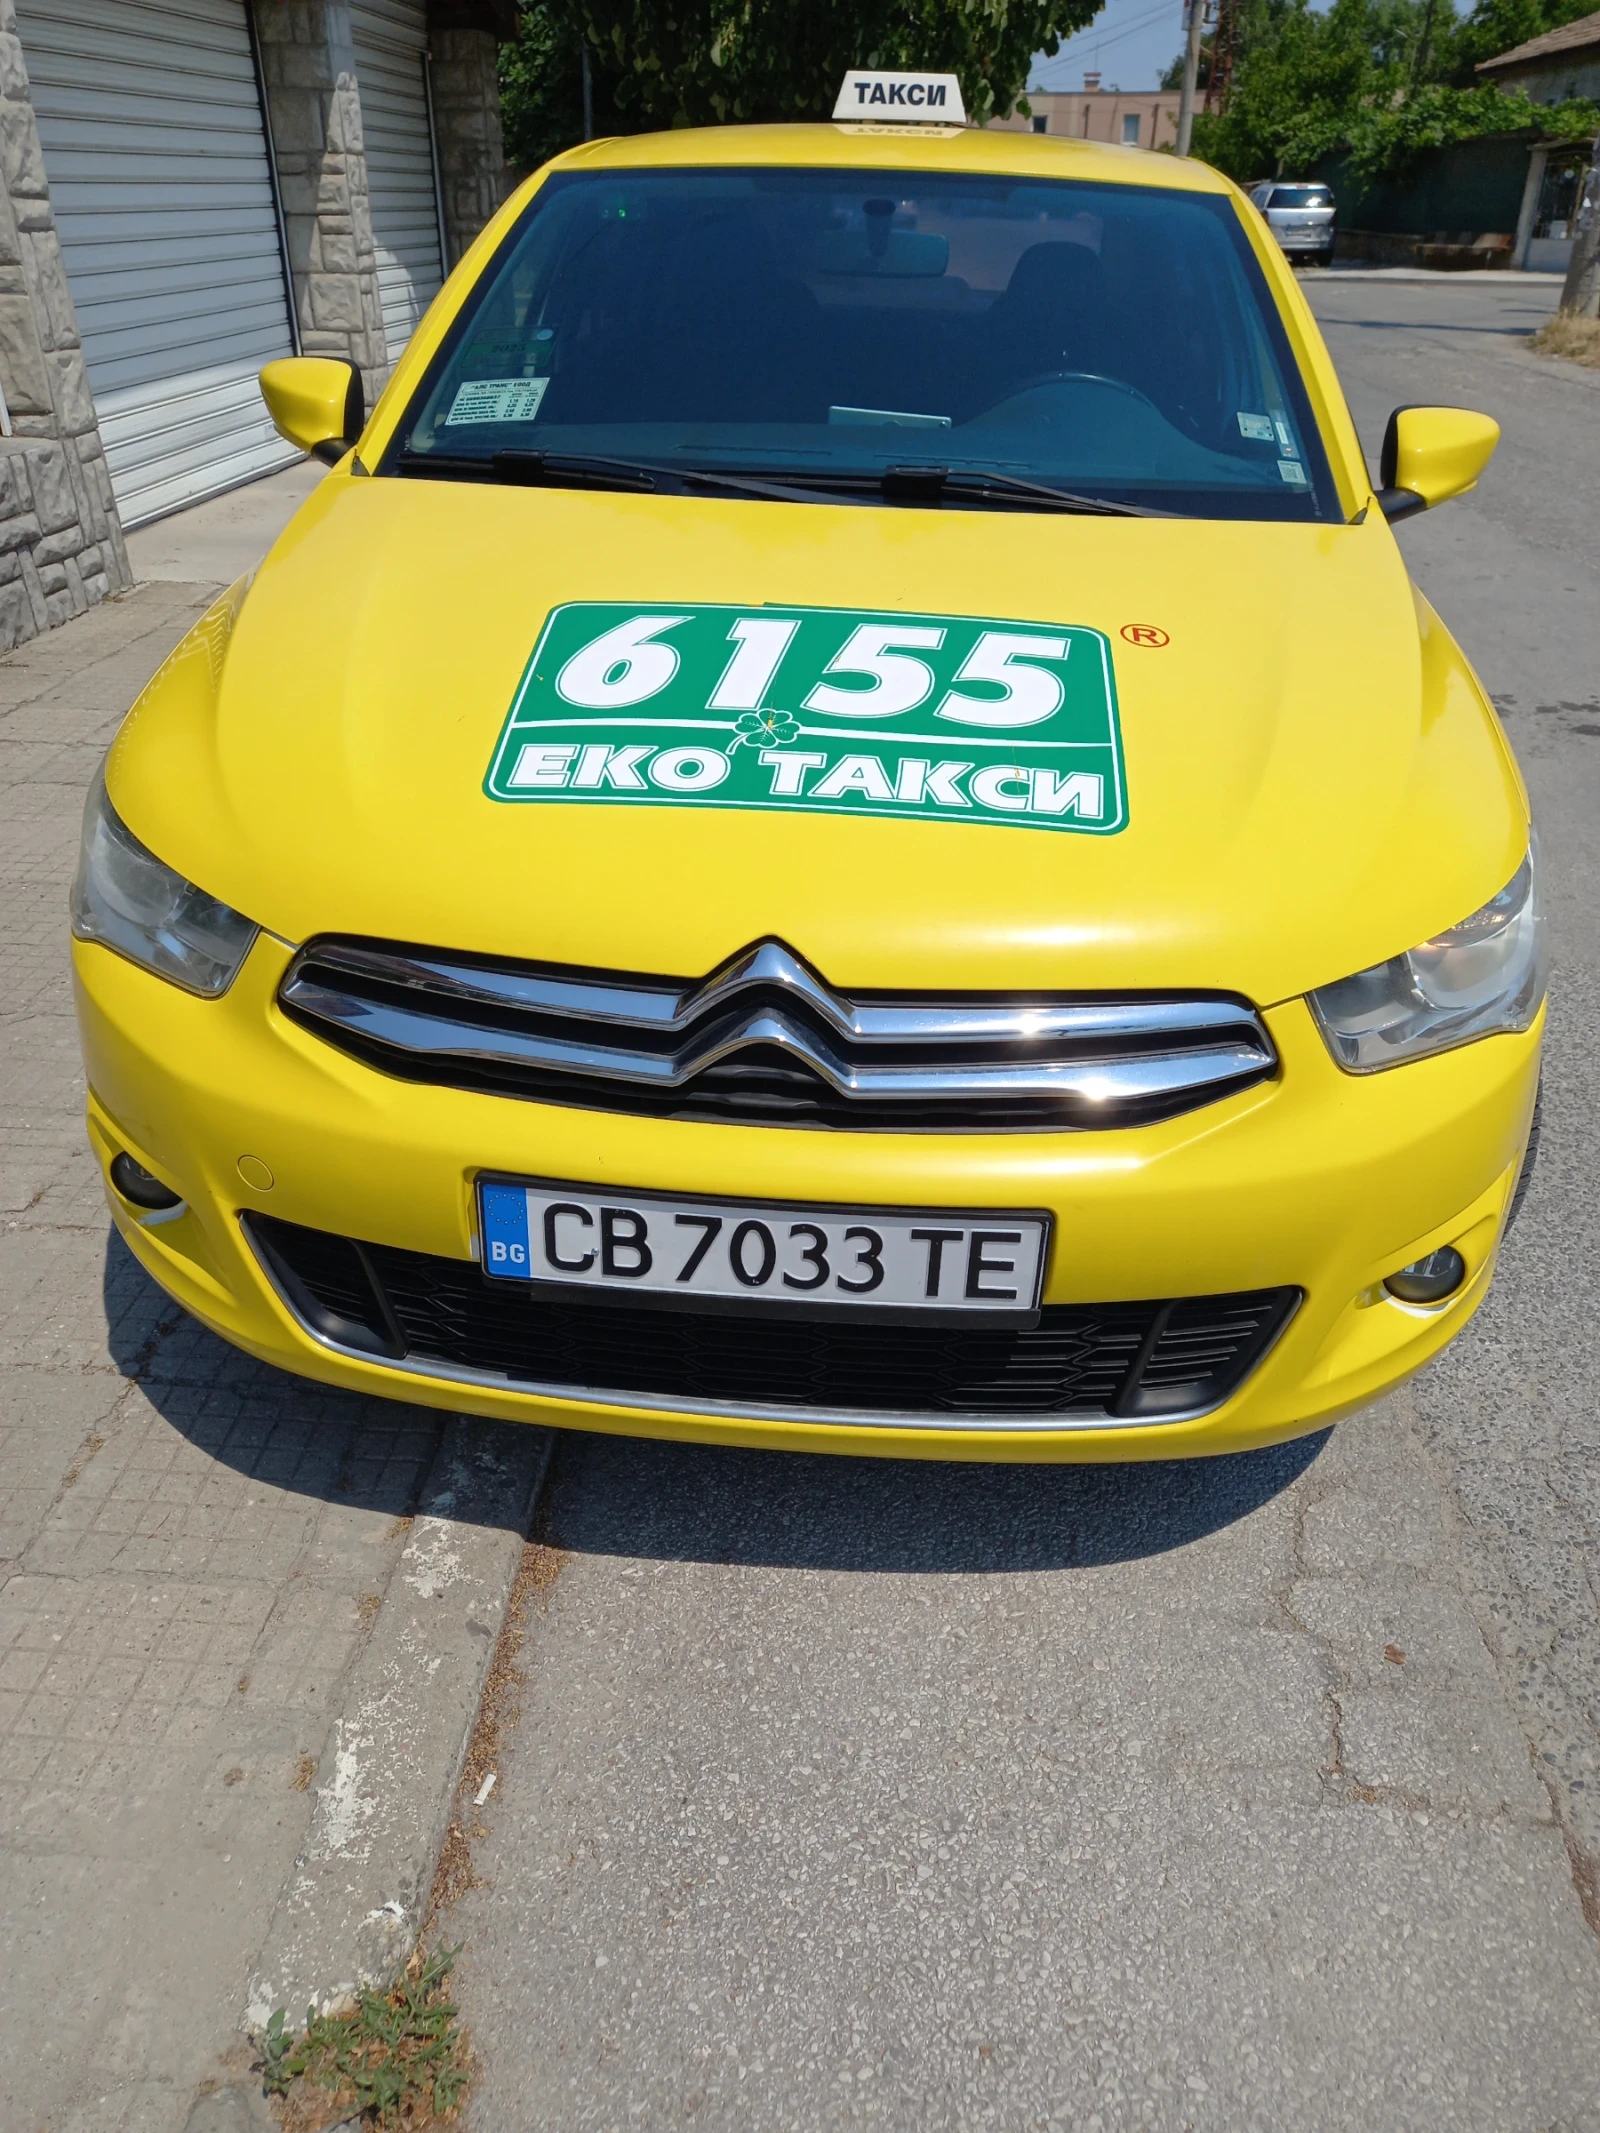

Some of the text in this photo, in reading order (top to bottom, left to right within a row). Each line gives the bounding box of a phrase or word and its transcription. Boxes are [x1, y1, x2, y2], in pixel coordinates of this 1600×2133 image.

[854, 82, 946, 106] ТАКСИ
[555, 614, 1071, 728] 6155
[506, 743, 1104, 819] ЕКО ТАКСИ
[491, 1240, 525, 1264] BG
[543, 1202, 1022, 1300] CB 7033 TE
